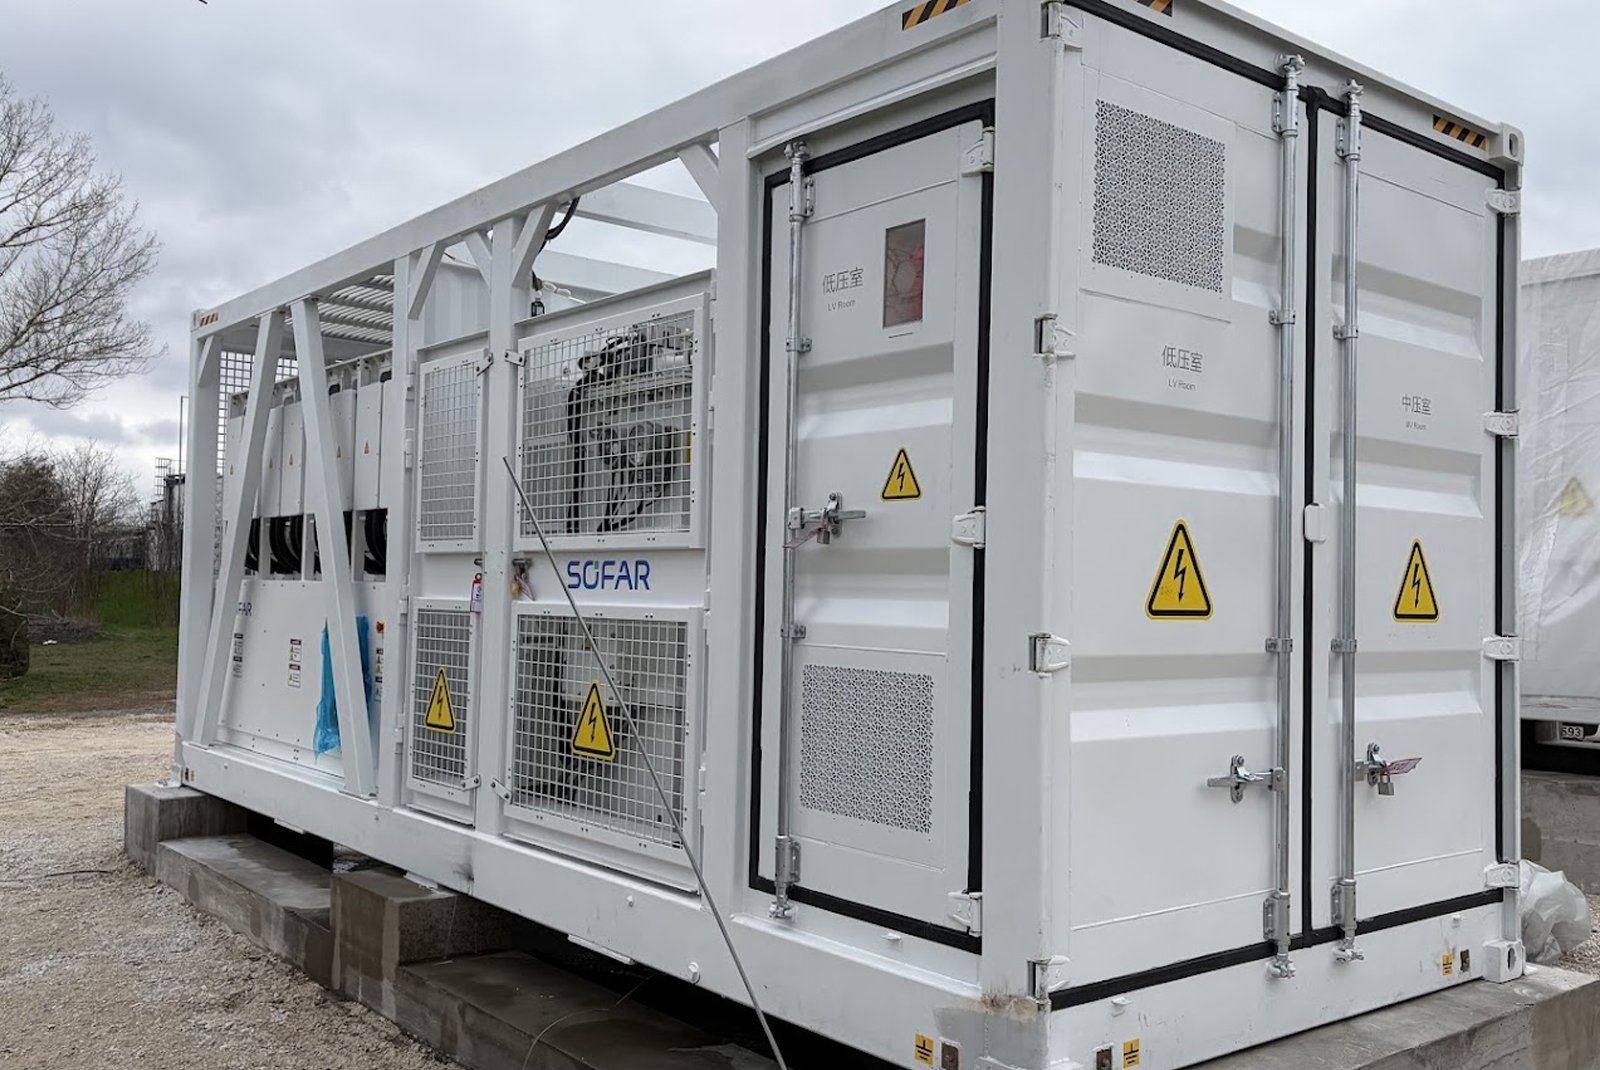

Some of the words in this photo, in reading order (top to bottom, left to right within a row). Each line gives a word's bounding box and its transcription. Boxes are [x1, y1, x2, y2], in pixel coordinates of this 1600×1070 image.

[822, 267, 864, 296] 低压室
[827, 302, 837, 312] LV
[1161, 344, 1203, 373] 低压室
[1168, 378, 1178, 388] LV
[1402, 393, 1431, 416] 中压室
[567, 560, 650, 590] SOFAR
